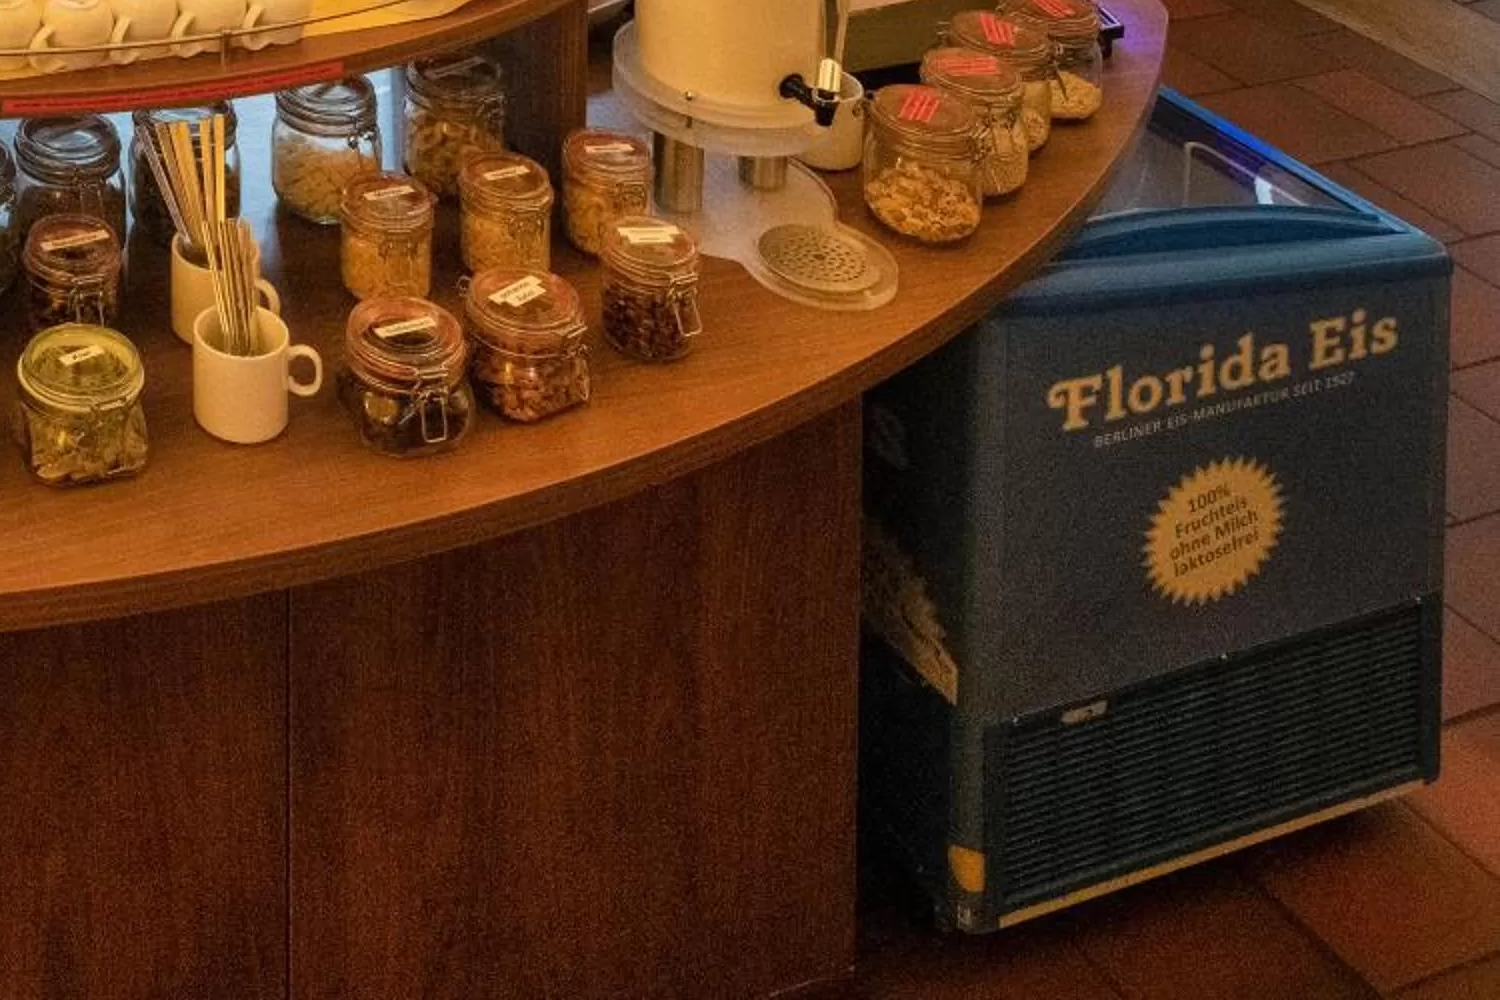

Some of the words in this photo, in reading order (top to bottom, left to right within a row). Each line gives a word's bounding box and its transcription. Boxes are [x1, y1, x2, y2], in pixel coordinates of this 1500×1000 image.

[1047, 331, 1292, 432] Florida
[1308, 307, 1399, 371] Eis
[1093, 421, 1162, 449] BERLINER
[1175, 495, 1248, 538] Fruchteis
[1187, 482, 1231, 513] 100%
[1170, 533, 1211, 561] ohne
[1214, 509, 1259, 540] Milch
[1173, 525, 1260, 578] laktosefrei
